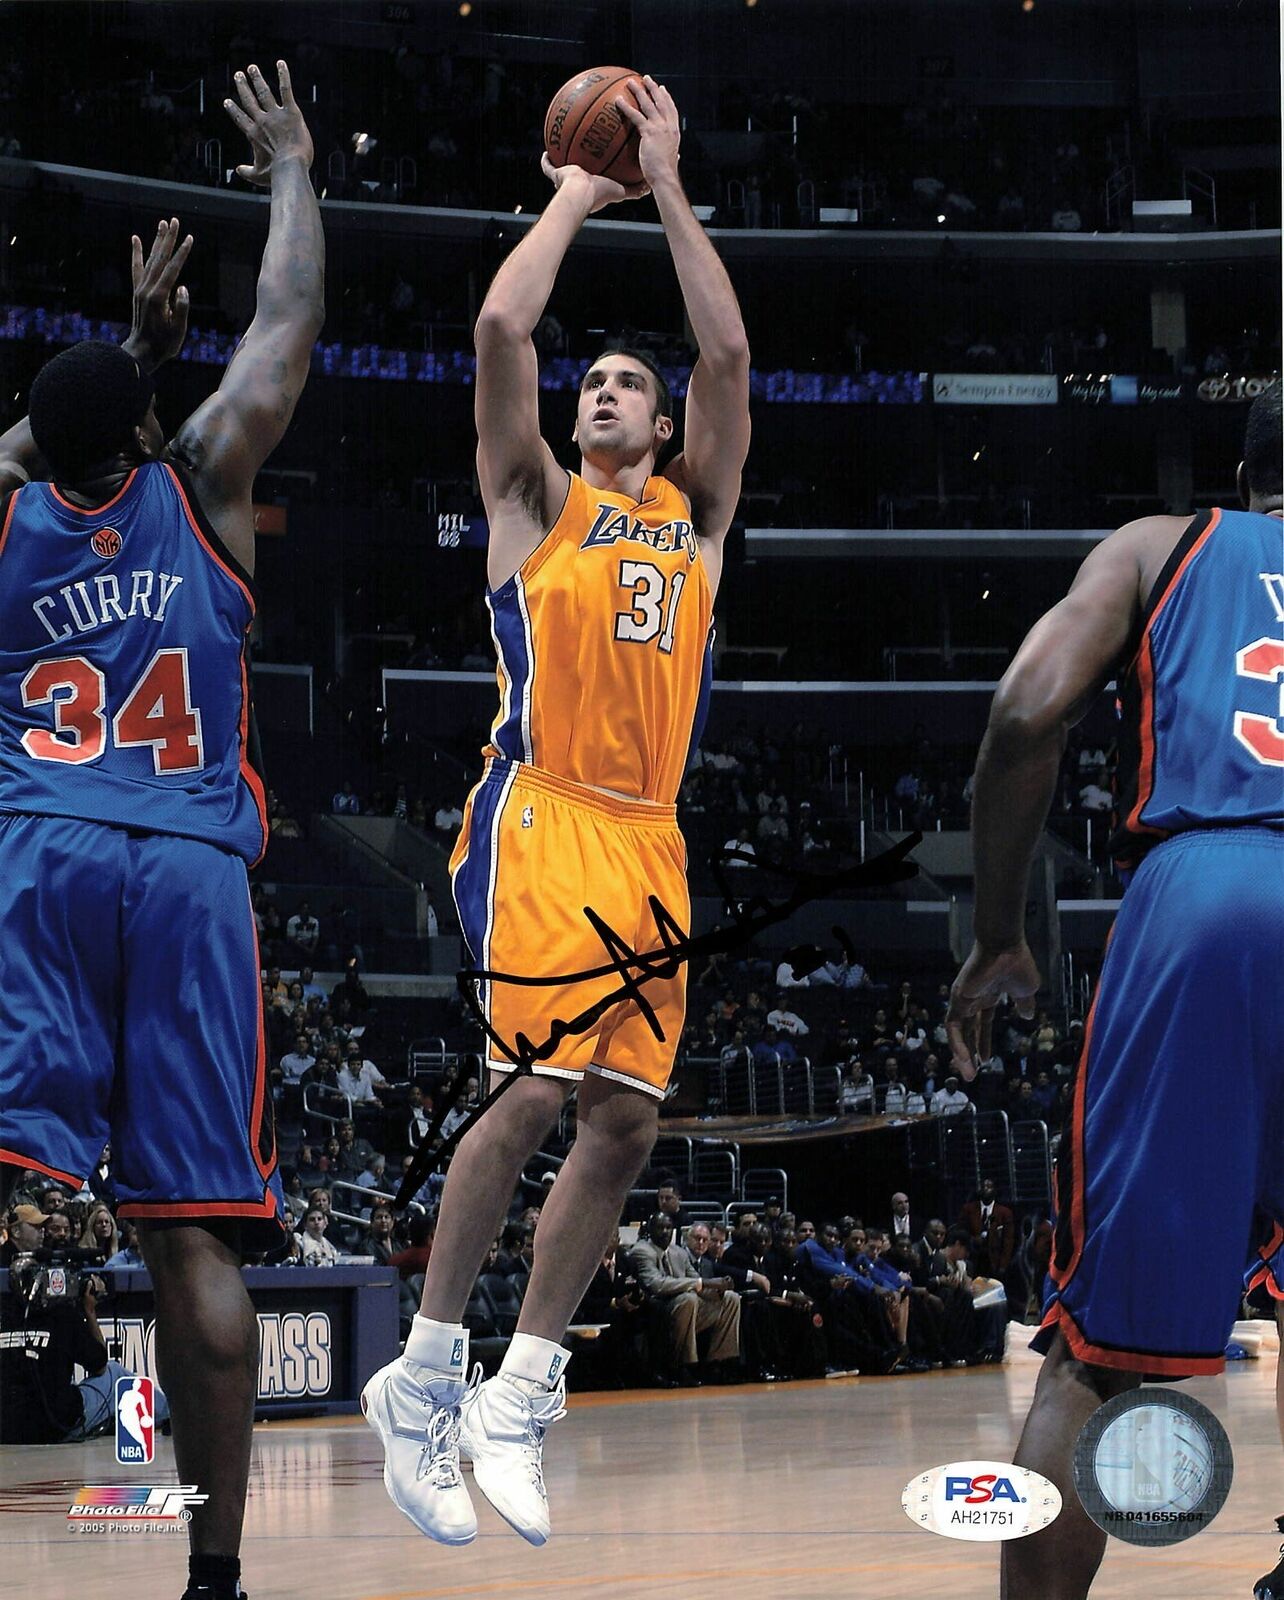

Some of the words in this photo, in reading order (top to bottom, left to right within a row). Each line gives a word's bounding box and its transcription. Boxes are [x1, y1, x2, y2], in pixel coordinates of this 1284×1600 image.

[32, 570, 183, 642] CURRY
[614, 559, 687, 655] 31
[20, 648, 204, 776] 34
[256, 1312, 332, 1399] ASS
[951, 1511, 1013, 1525] AH21751
